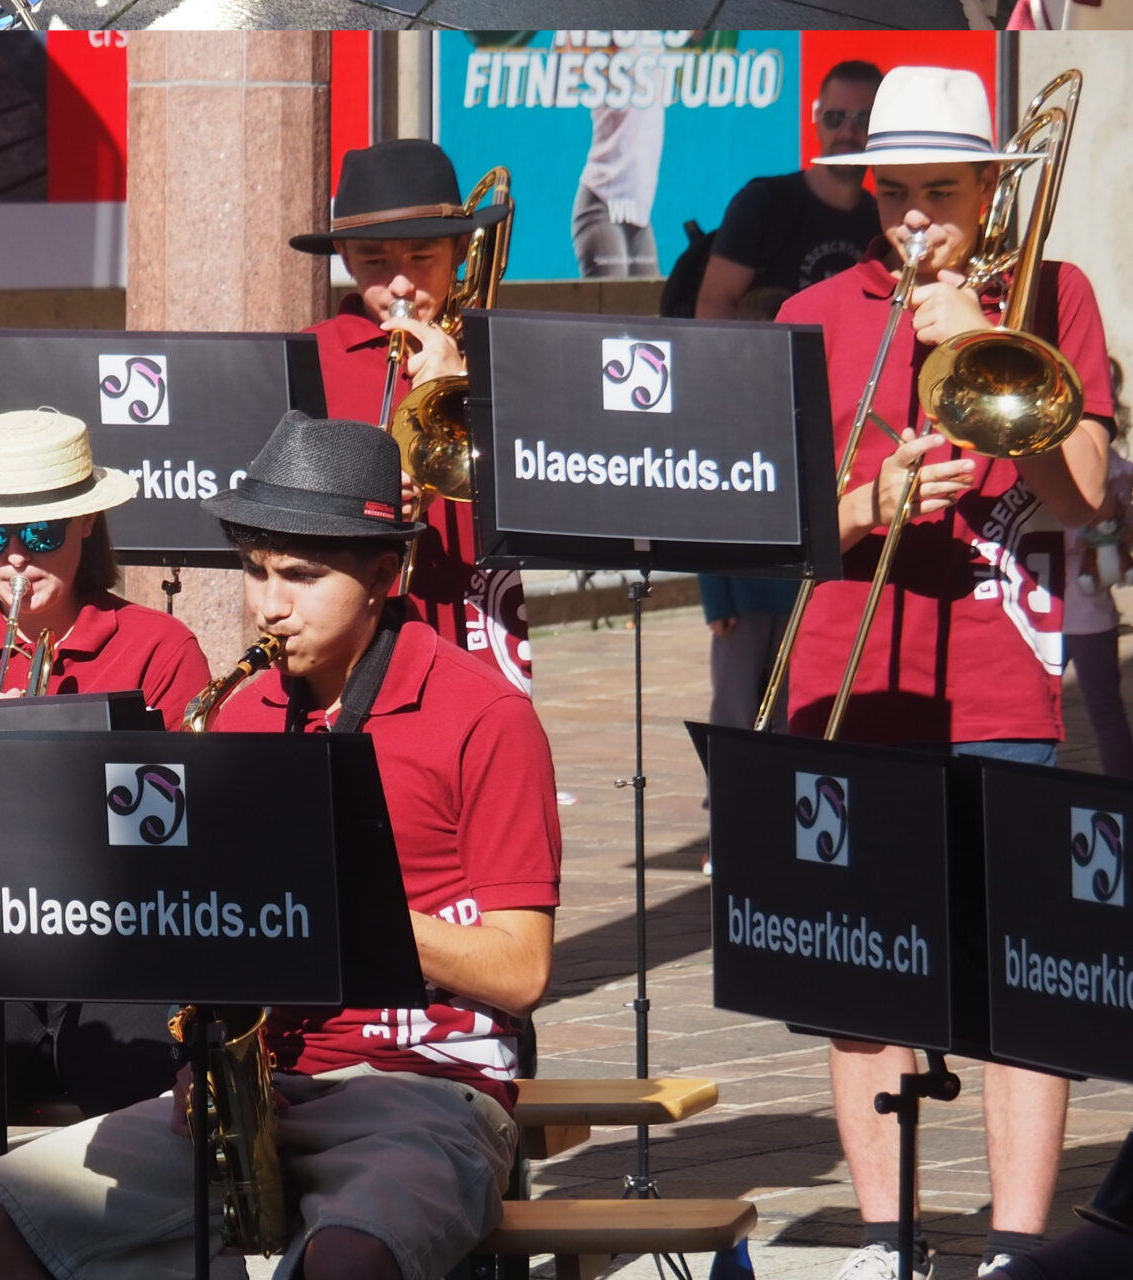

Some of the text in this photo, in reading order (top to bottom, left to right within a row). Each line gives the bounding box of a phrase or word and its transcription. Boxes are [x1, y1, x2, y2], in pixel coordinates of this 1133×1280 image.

[464, 52, 778, 109] FITNESSSTUDIO
[514, 438, 776, 493] blaeserkids.ch
[1, 886, 310, 938] blaeserkids.ch
[728, 894, 928, 976] blaeserkids.ch
